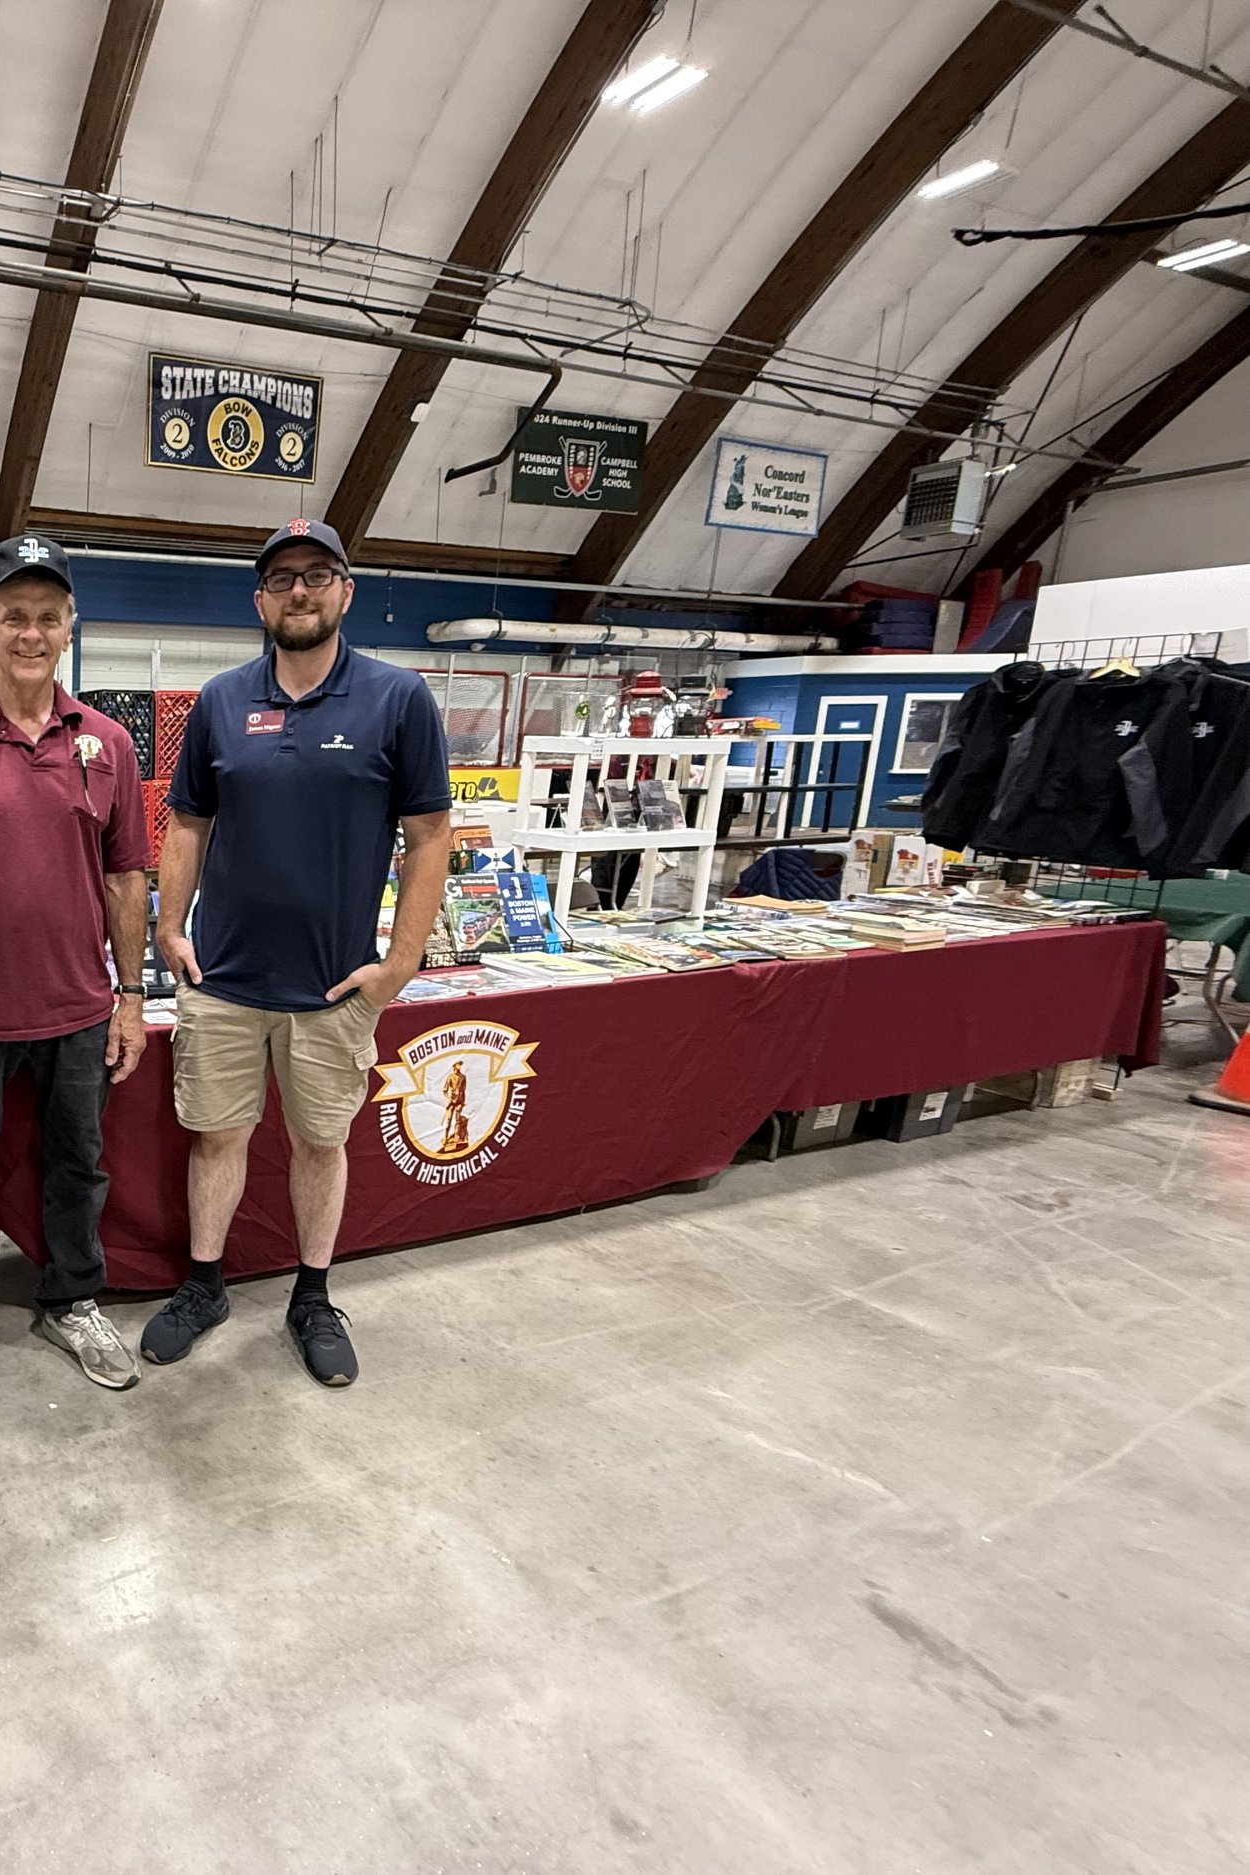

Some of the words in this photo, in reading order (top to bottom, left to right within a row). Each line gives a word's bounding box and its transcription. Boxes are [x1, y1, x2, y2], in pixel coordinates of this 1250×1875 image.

[161, 365, 215, 400] STATE
[218, 369, 314, 419] CHAMPIONS
[160, 407, 196, 427] DIVISION
[223, 401, 253, 418] BOW
[172, 423, 182, 444] 2
[275, 422, 309, 441] DIVISION
[552, 416, 594, 430] Runner-Up
[596, 421, 627, 433] Division
[211, 438, 260, 468] FALCONS
[286, 437, 297, 456] 2
[518, 452, 562, 465] PEMBROKE
[600, 457, 638, 469] CAMPBELL
[519, 465, 559, 476] ACADEMY
[609, 468, 628, 478] HIGH
[764, 464, 806, 484] Concord
[602, 478, 632, 489] SCHOOL
[753, 483, 810, 503] Nor'Easters
[408, 1030, 456, 1065] BOSTON
[457, 1030, 474, 1045] and
[474, 1028, 510, 1052] MAINE
[379, 1102, 420, 1176] RAILROAD
[416, 1146, 499, 1185] HISTORICAL
[494, 1082, 529, 1147] SOCIETY
